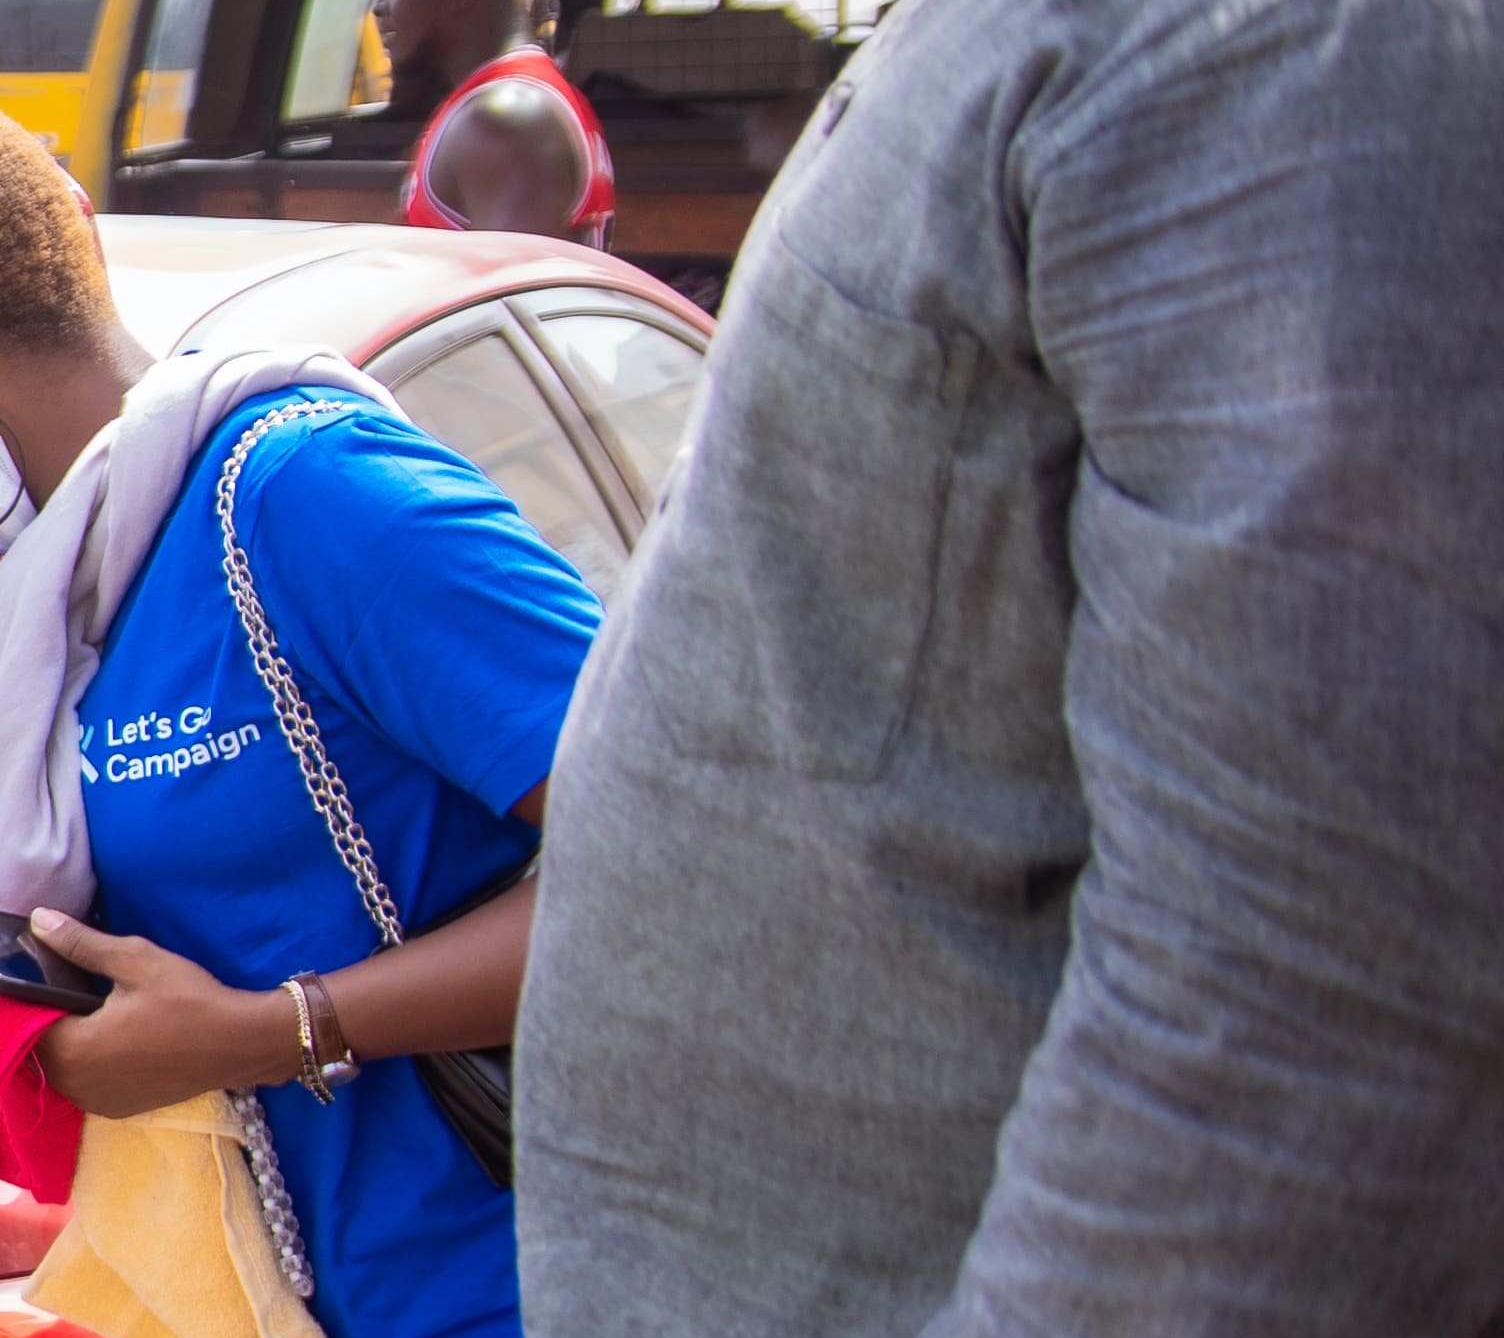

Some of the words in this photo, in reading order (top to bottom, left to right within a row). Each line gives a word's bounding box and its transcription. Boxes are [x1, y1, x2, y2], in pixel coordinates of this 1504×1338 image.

[106, 711, 173, 747] Let's
[179, 706, 212, 735] Go
[106, 723, 261, 783] Campaign
